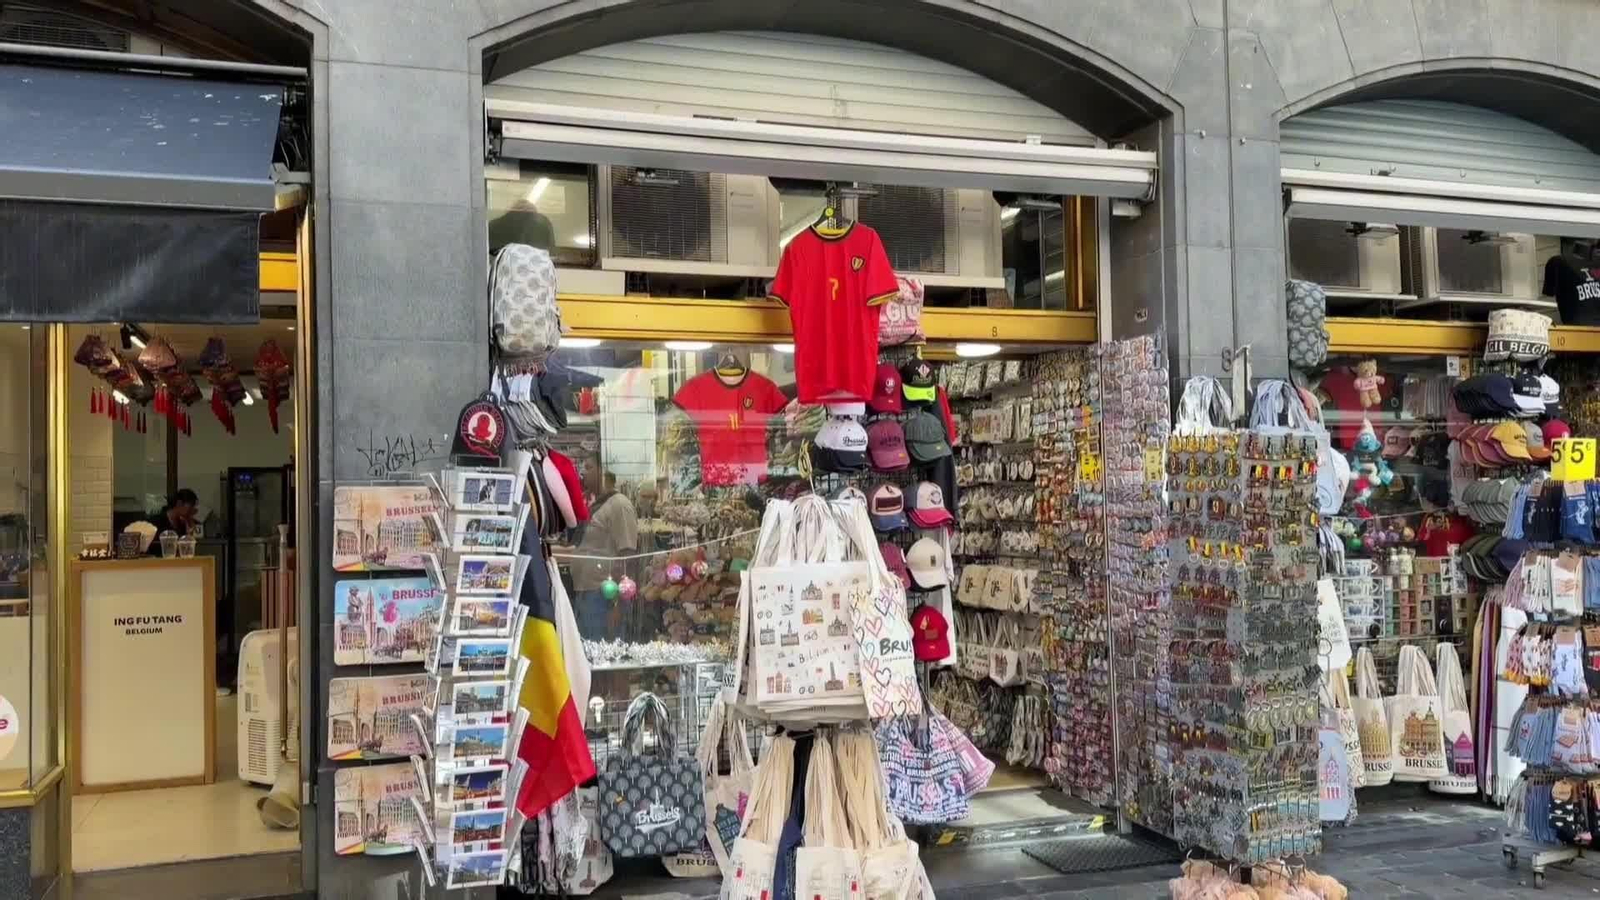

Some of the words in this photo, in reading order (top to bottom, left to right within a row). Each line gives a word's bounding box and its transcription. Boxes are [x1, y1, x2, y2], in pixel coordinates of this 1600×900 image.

[1556, 336, 1566, 347] 10
[114, 617, 134, 626] ING
[136, 617, 150, 625] FU
[152, 615, 182, 624] TANG
[125, 627, 163, 635] BELGIUM
